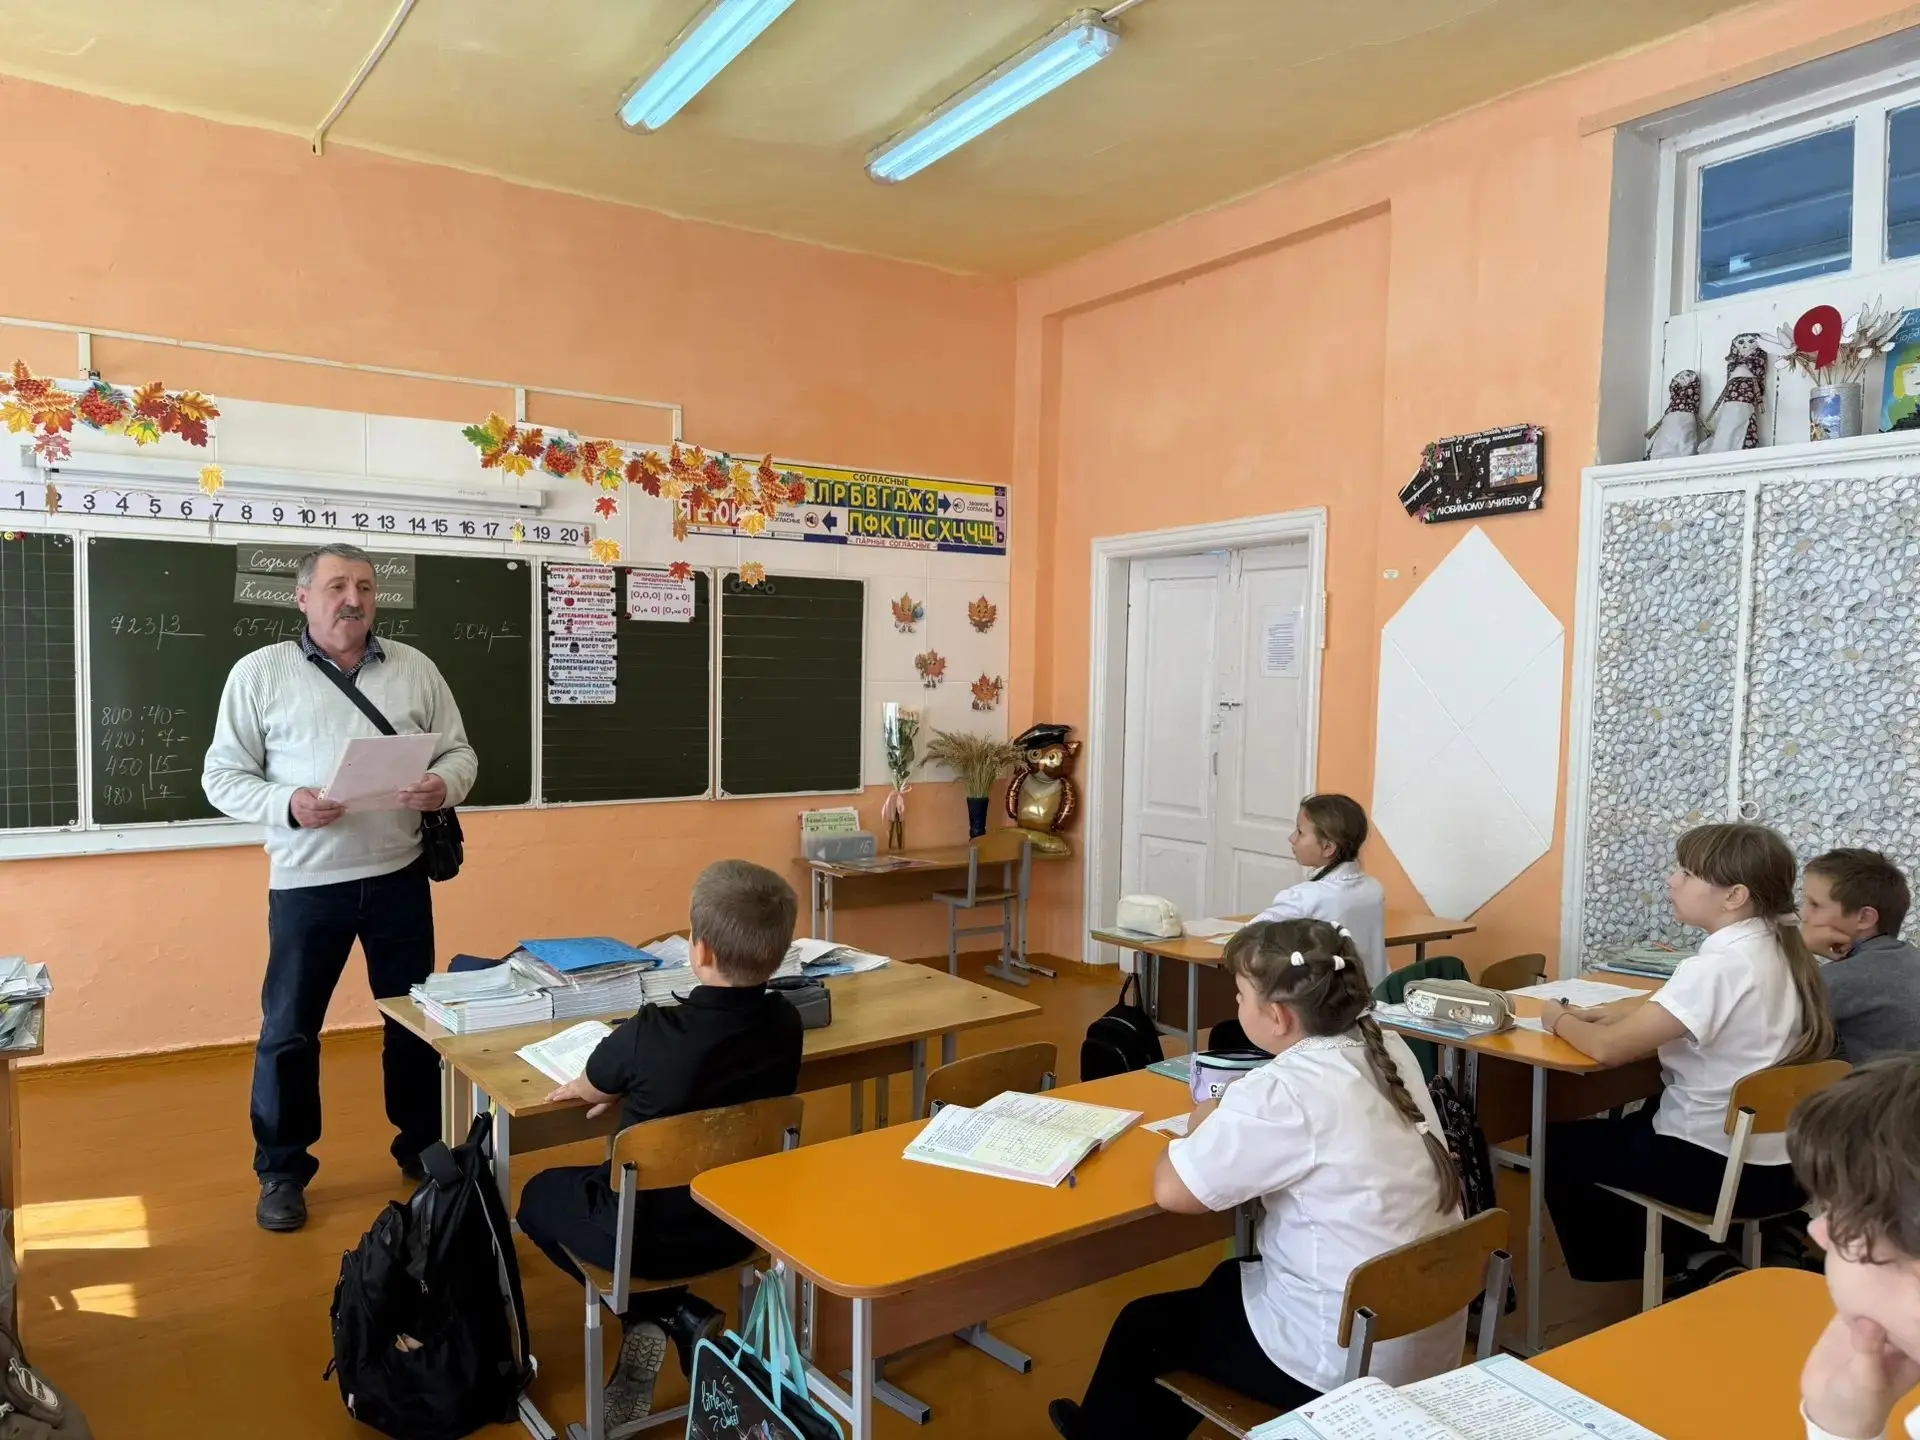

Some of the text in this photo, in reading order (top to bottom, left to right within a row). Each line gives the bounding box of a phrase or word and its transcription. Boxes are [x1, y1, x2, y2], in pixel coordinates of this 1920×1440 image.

[1794, 304, 1842, 370] 9
[852, 473, 909, 487] СОГЛАСНЫЕ
[15, 490, 25, 506] 1
[83, 494, 96, 510] 3
[116, 496, 129, 512] 4
[149, 498, 161, 514] 5
[181, 500, 192, 516] 6
[213, 503, 224, 518] 7
[241, 505, 253, 520] 8
[272, 507, 284, 522] 9
[298, 509, 315, 525] 10
[322, 511, 337, 526] 11
[351, 513, 369, 528] 12
[377, 515, 395, 530] 13
[408, 516, 427, 532] 14
[431, 518, 448, 534] 15
[459, 520, 475, 535] 16
[483, 522, 500, 536] 17
[533, 526, 551, 540] 19
[560, 528, 579, 542] 20
[1436, 495, 1527, 516] ЛЮБИМОМУ УЧИТЕЛЮ
[855, 537, 931, 550] ПАРНЫЕ СОГЛАСНЫЕ
[250, 549, 299, 572] Седьм
[239, 580, 297, 603] Классн
